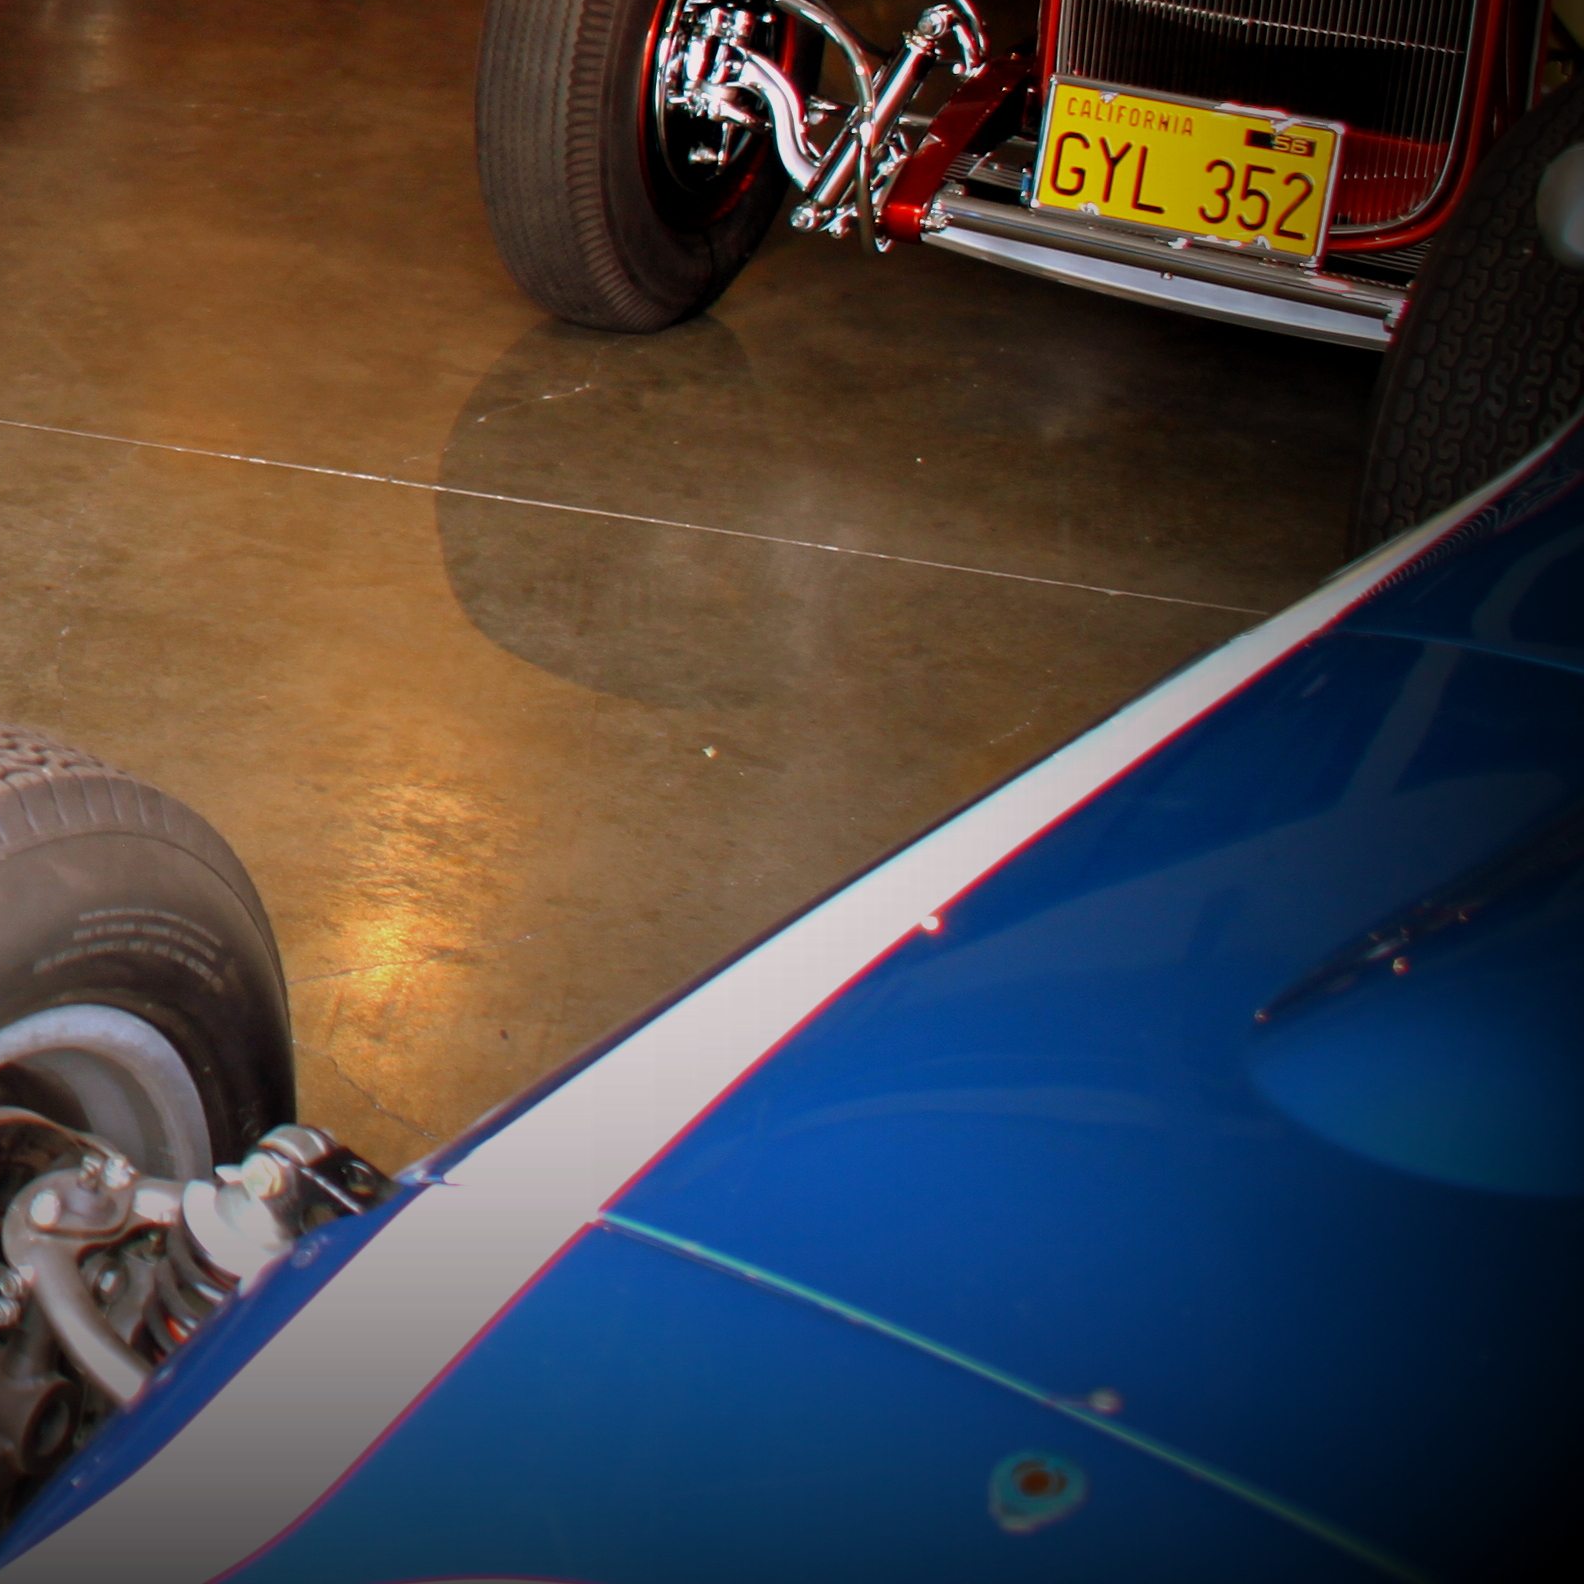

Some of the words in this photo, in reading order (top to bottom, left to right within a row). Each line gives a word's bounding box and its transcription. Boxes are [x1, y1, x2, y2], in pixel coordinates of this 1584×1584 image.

[1066, 95, 1196, 137] CALIFORNIA
[1050, 131, 1165, 215] GYL
[1198, 159, 1313, 241] 352
